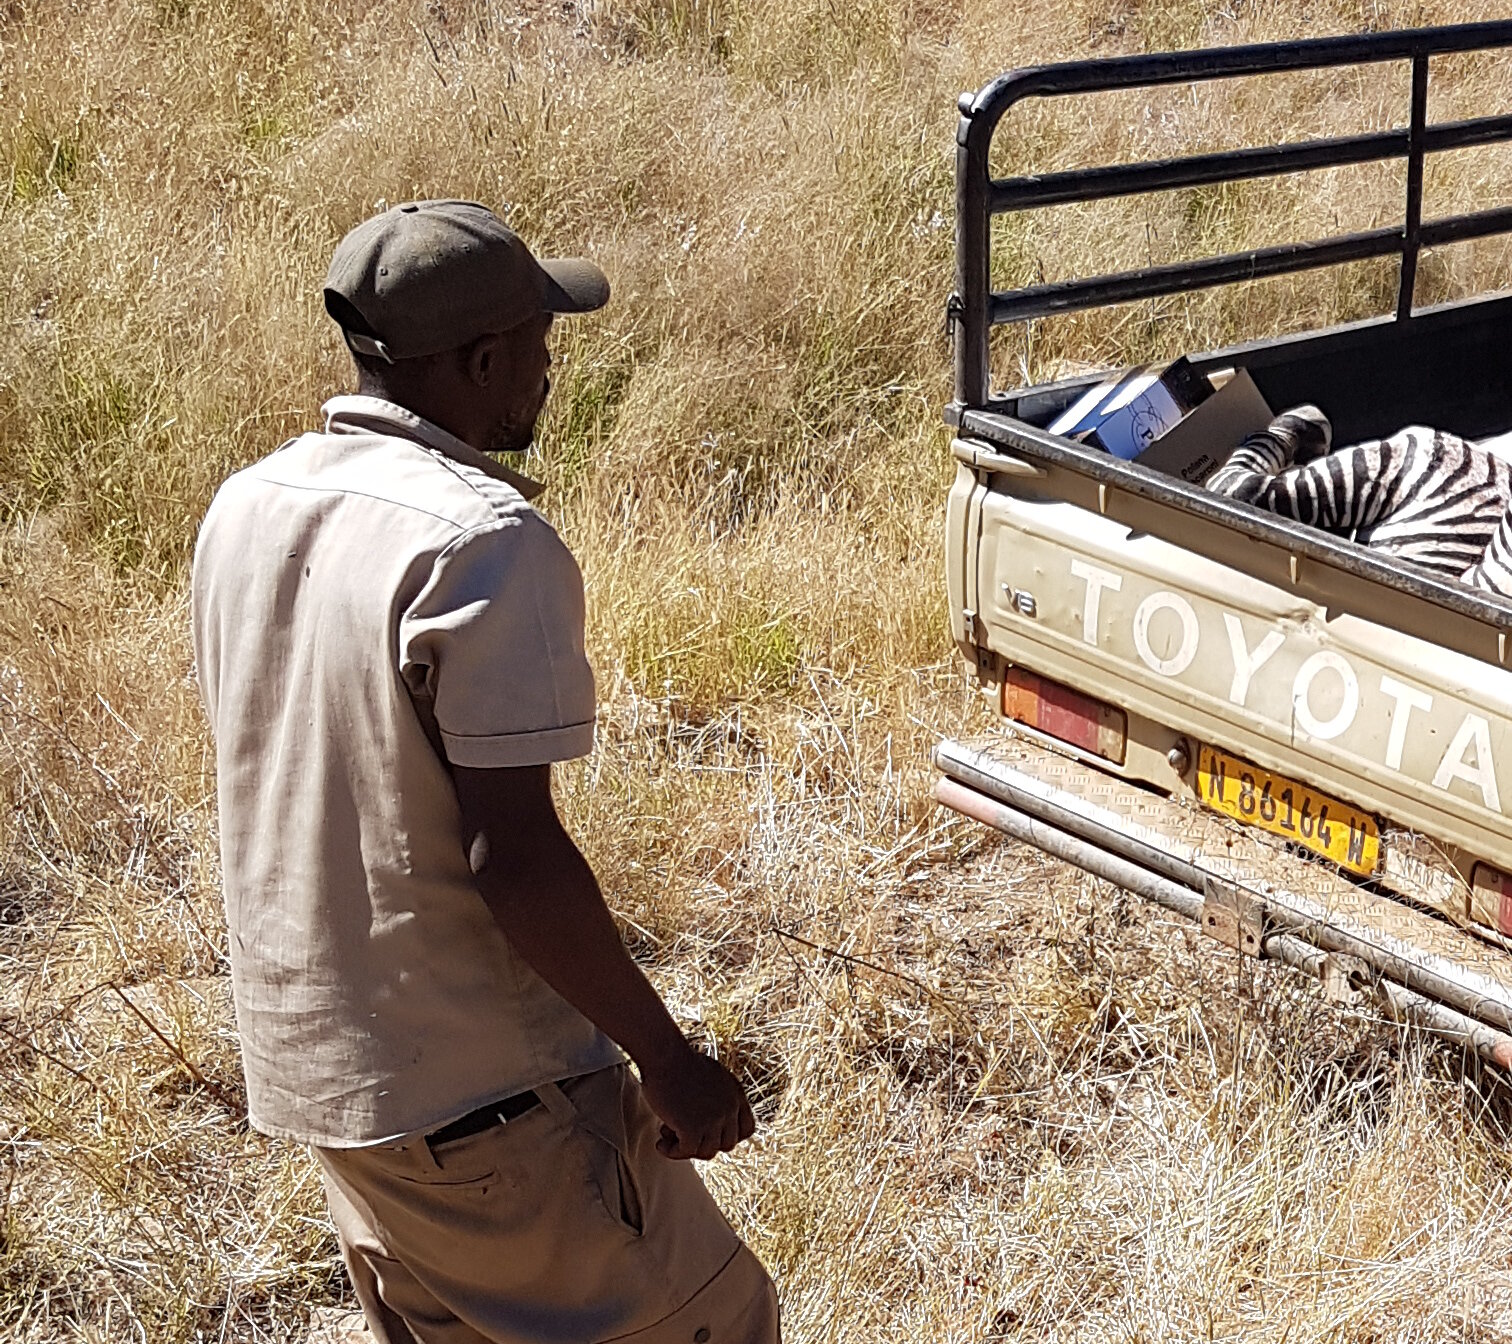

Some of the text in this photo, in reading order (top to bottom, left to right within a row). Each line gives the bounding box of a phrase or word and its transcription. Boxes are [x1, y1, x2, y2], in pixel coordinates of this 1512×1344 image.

[1071, 559, 1502, 813] TOYOTA
[1209, 755, 1367, 867] N 86164 W
